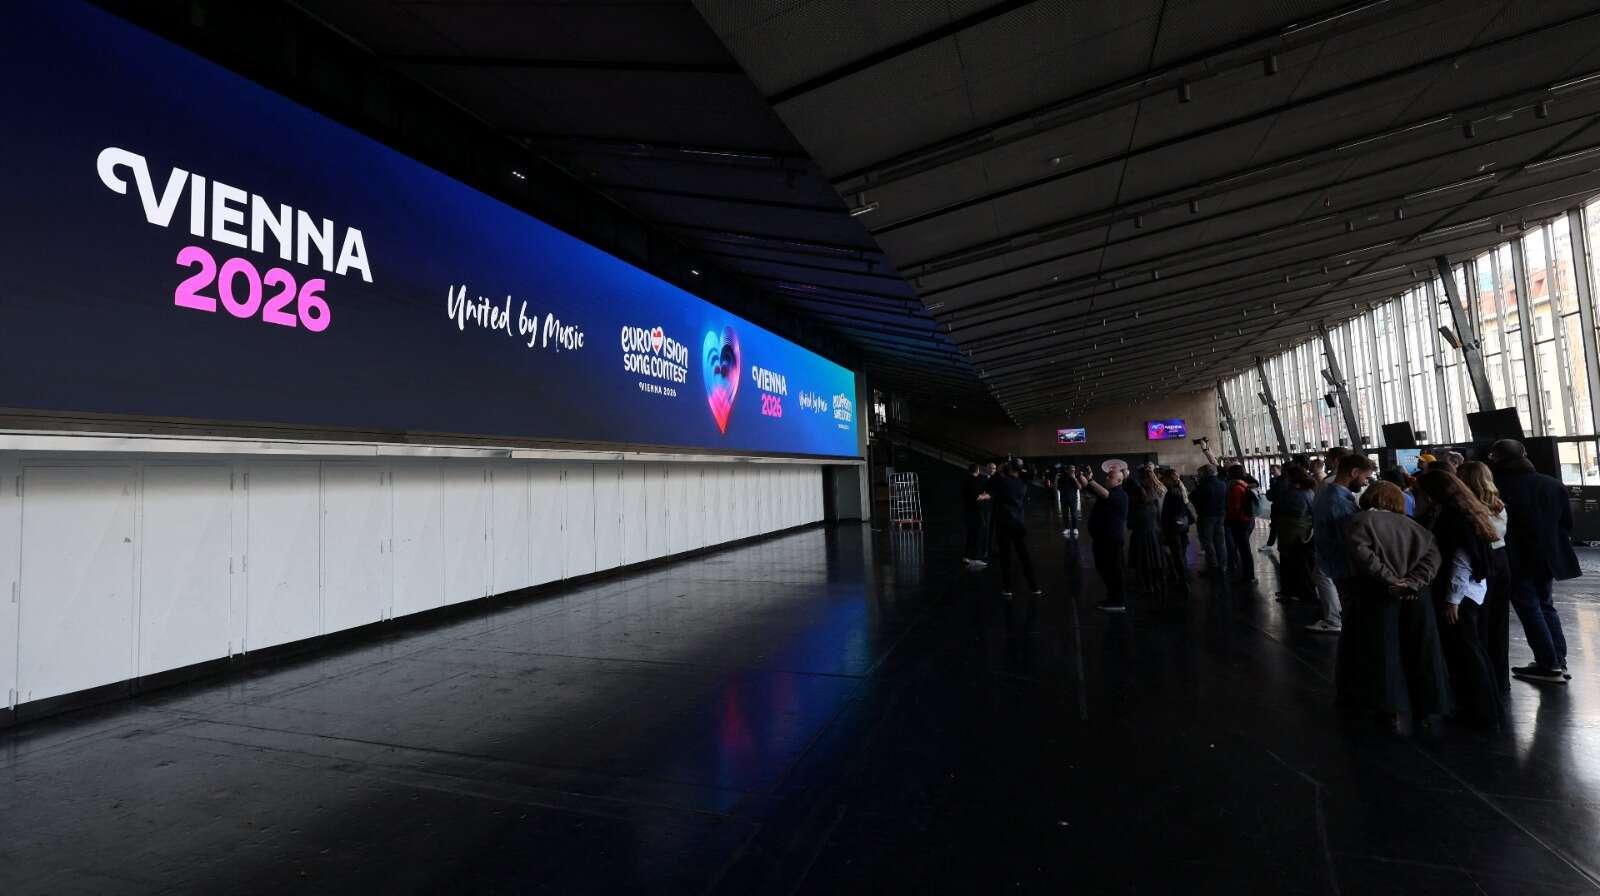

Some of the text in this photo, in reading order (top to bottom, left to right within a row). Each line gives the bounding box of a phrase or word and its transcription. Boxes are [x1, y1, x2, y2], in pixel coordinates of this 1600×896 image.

[97, 147, 373, 283] VIENNA
[174, 246, 331, 332] 2026
[447, 284, 584, 353] United by Music
[638, 381, 677, 397] VIENNA 2026
[752, 365, 787, 396] VIENNA
[761, 393, 783, 418] 2026
